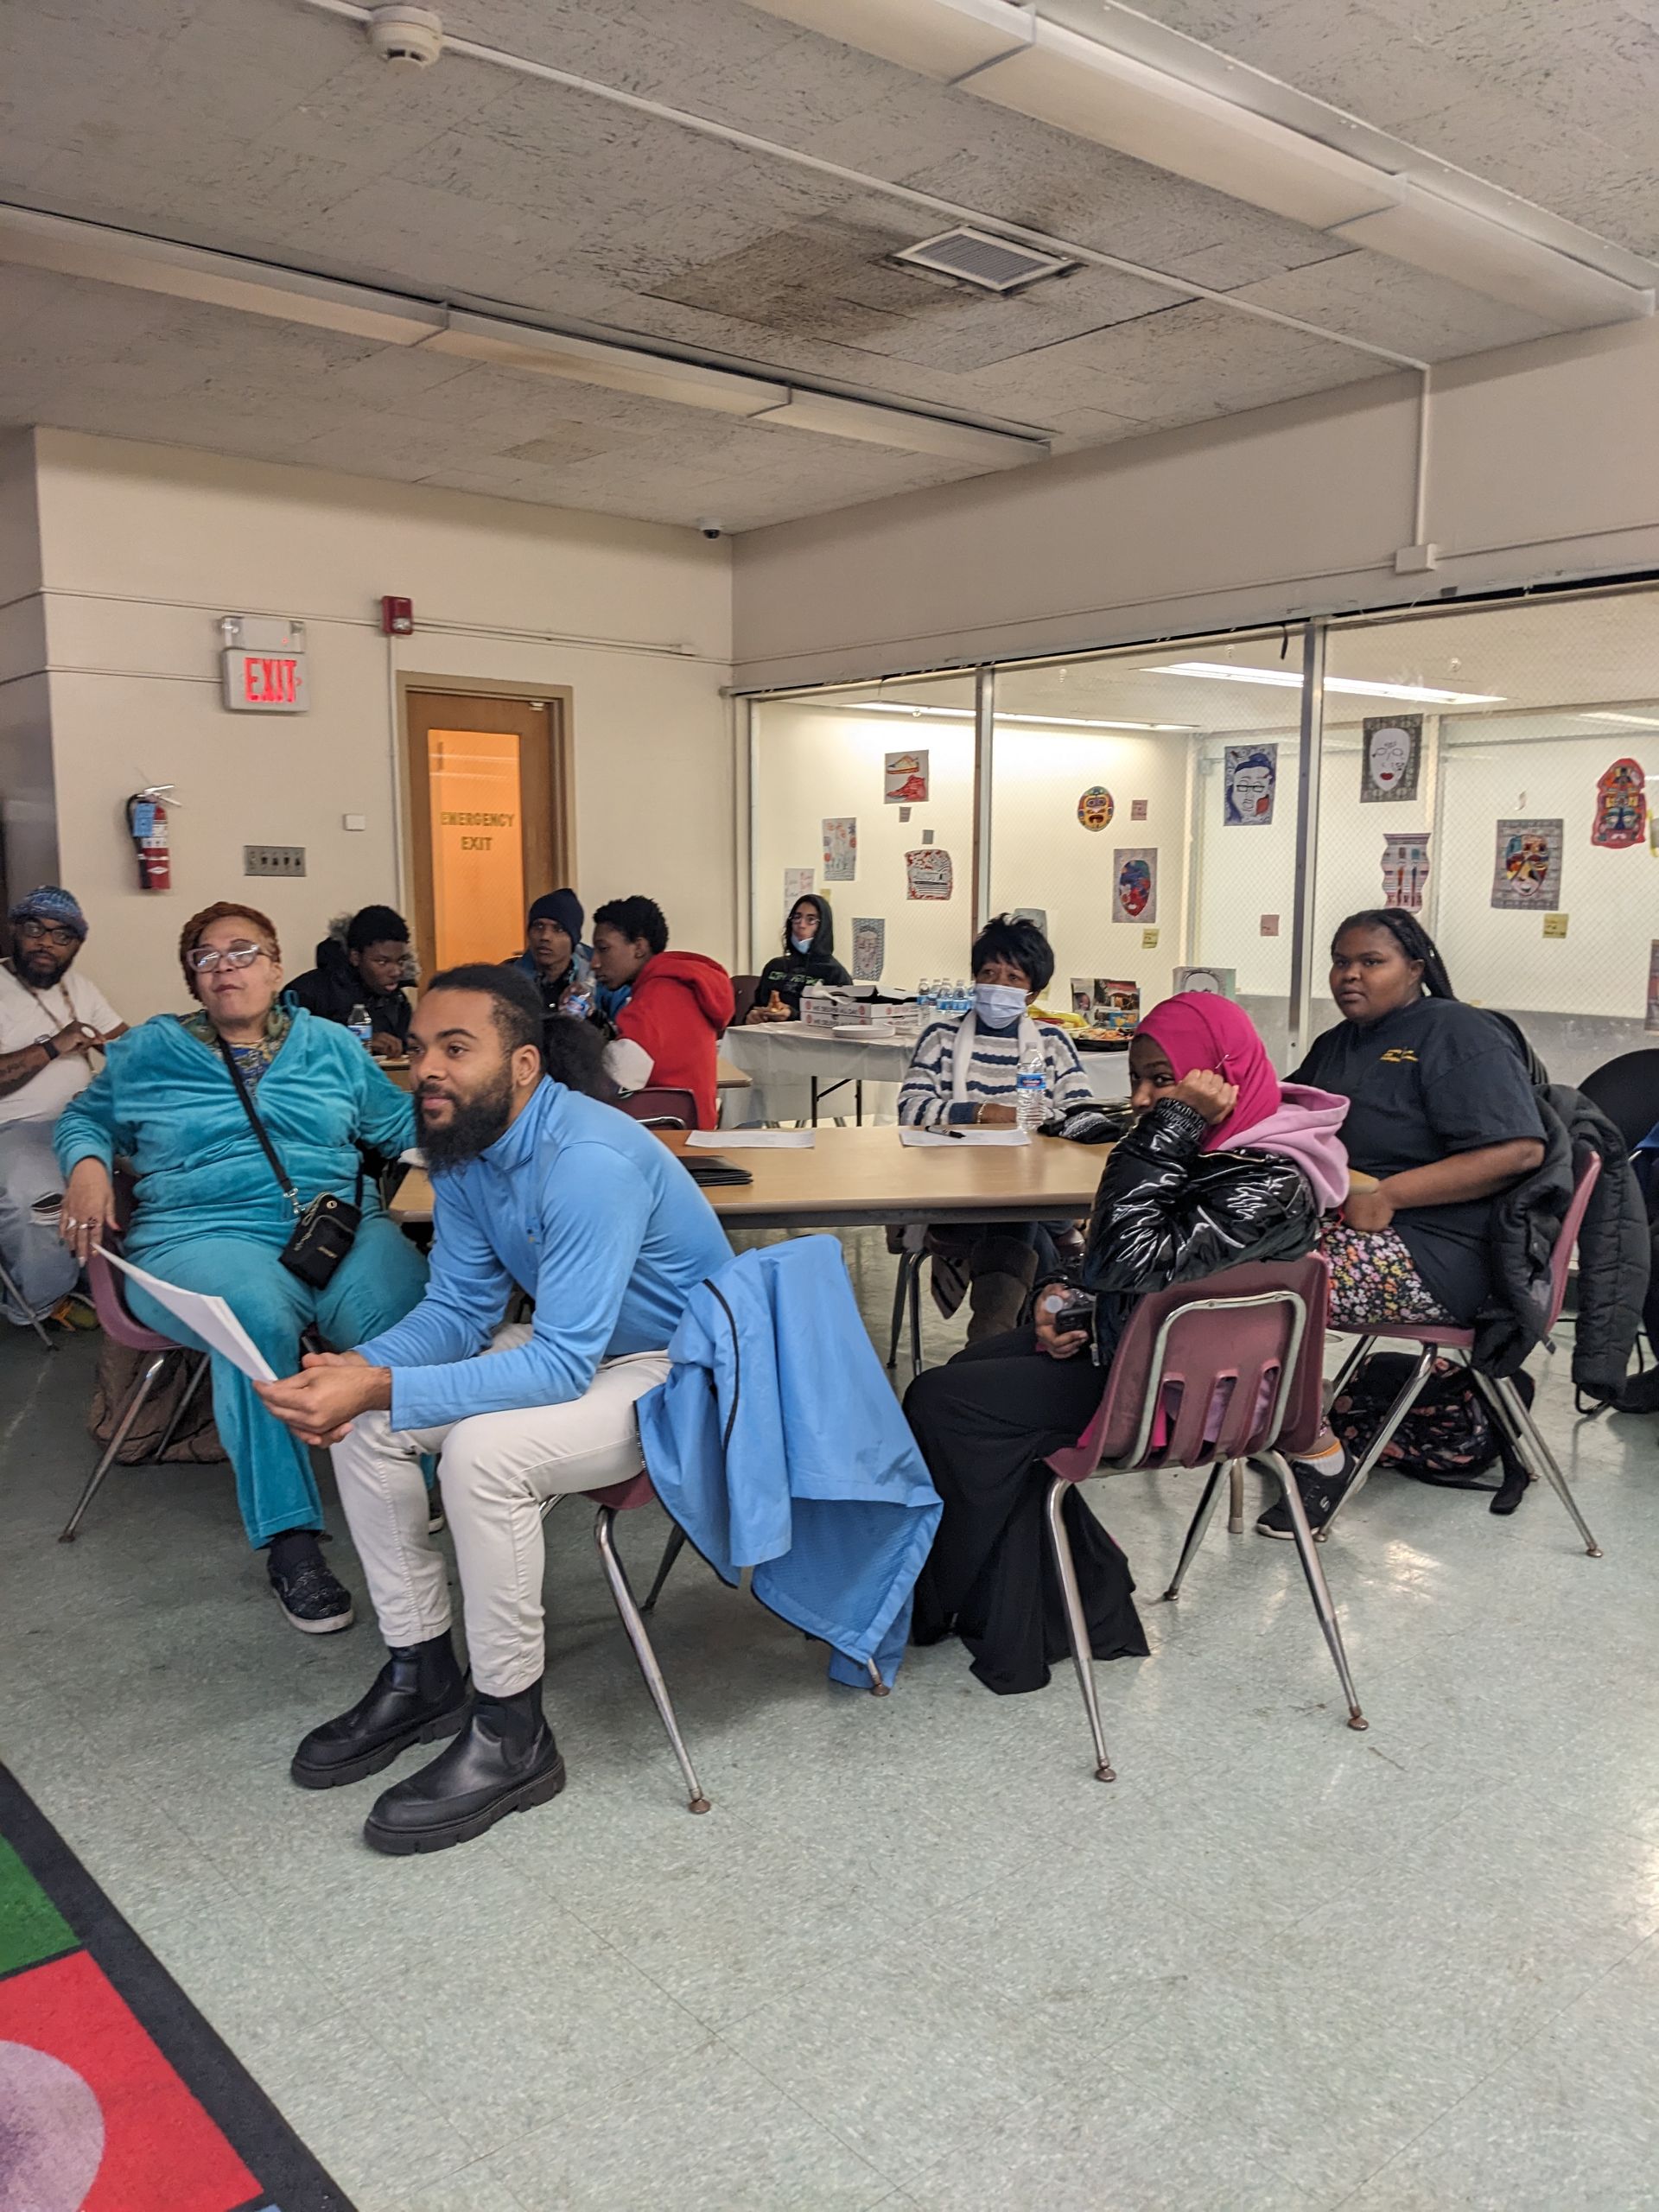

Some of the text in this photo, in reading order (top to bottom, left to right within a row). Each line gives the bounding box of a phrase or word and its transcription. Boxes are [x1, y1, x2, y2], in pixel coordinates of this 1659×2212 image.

[245, 657, 297, 702] EXIT
[442, 811, 515, 827] EMERGENCY
[461, 836, 493, 851] EXIT
